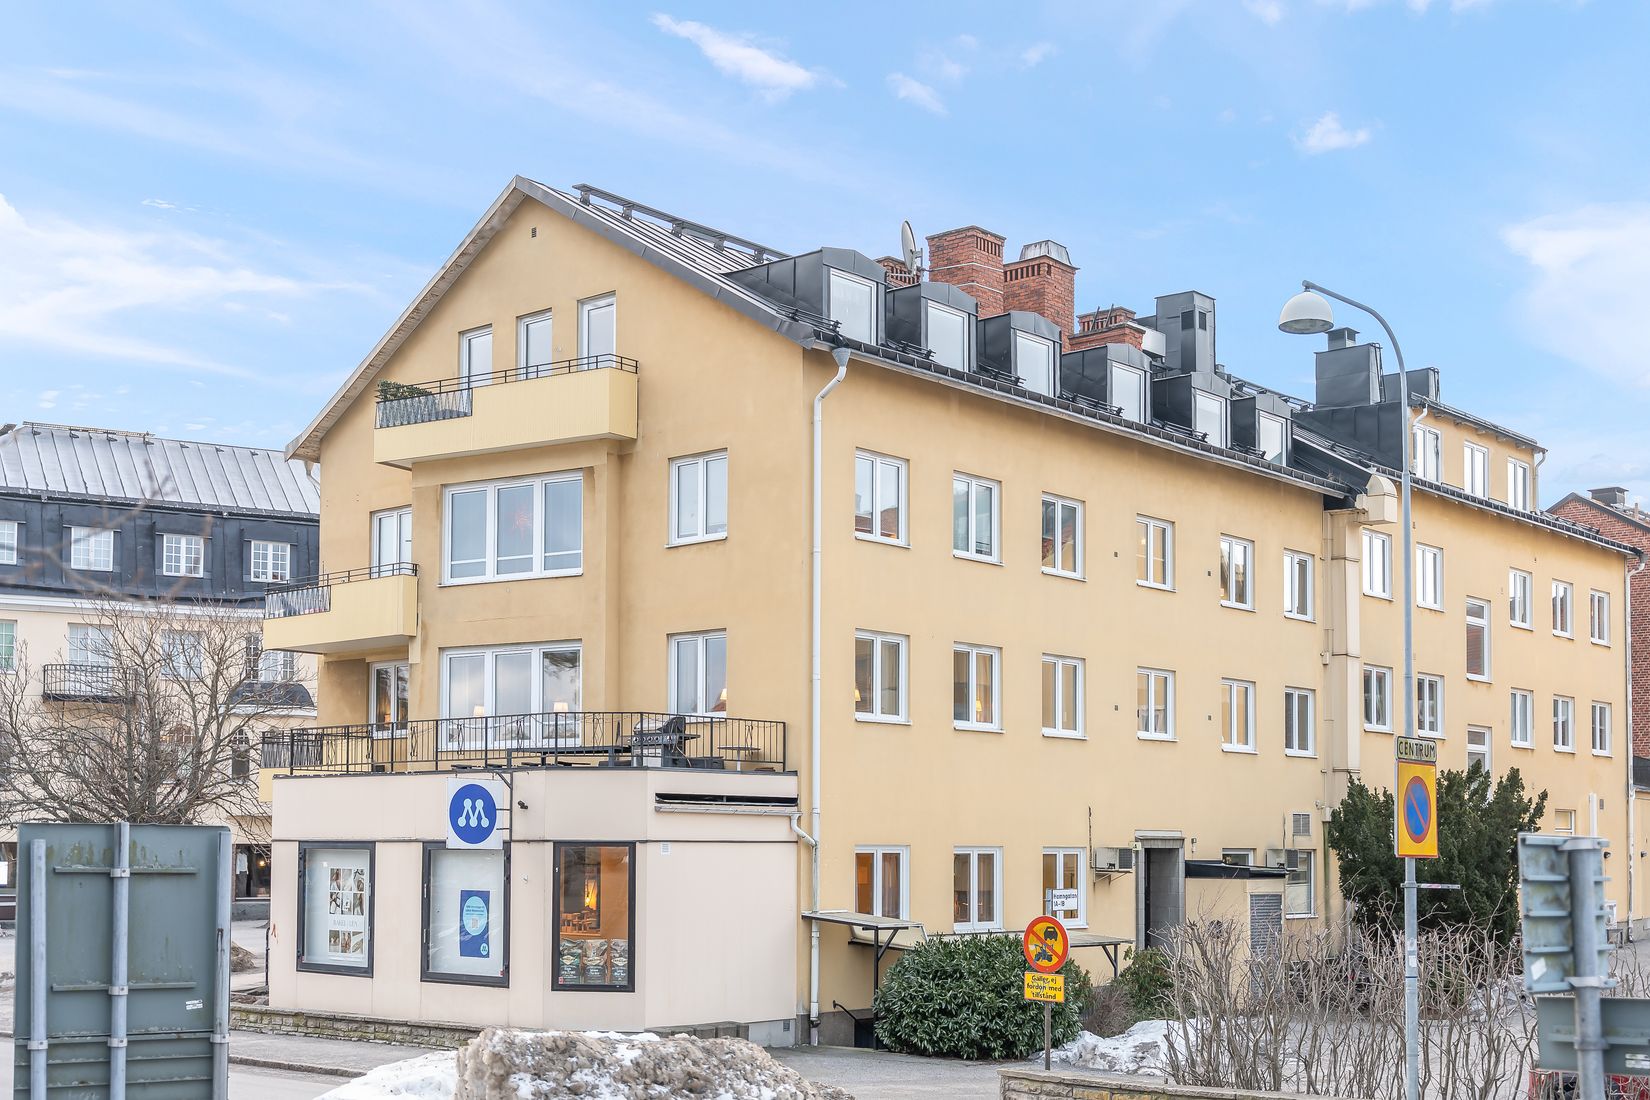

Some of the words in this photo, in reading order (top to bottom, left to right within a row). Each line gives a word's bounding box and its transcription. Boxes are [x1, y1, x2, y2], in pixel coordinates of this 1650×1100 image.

[1399, 741, 1435, 757] CENTRUM
[1051, 976, 1057, 984] ej
[1032, 991, 1056, 999] tillstånd
